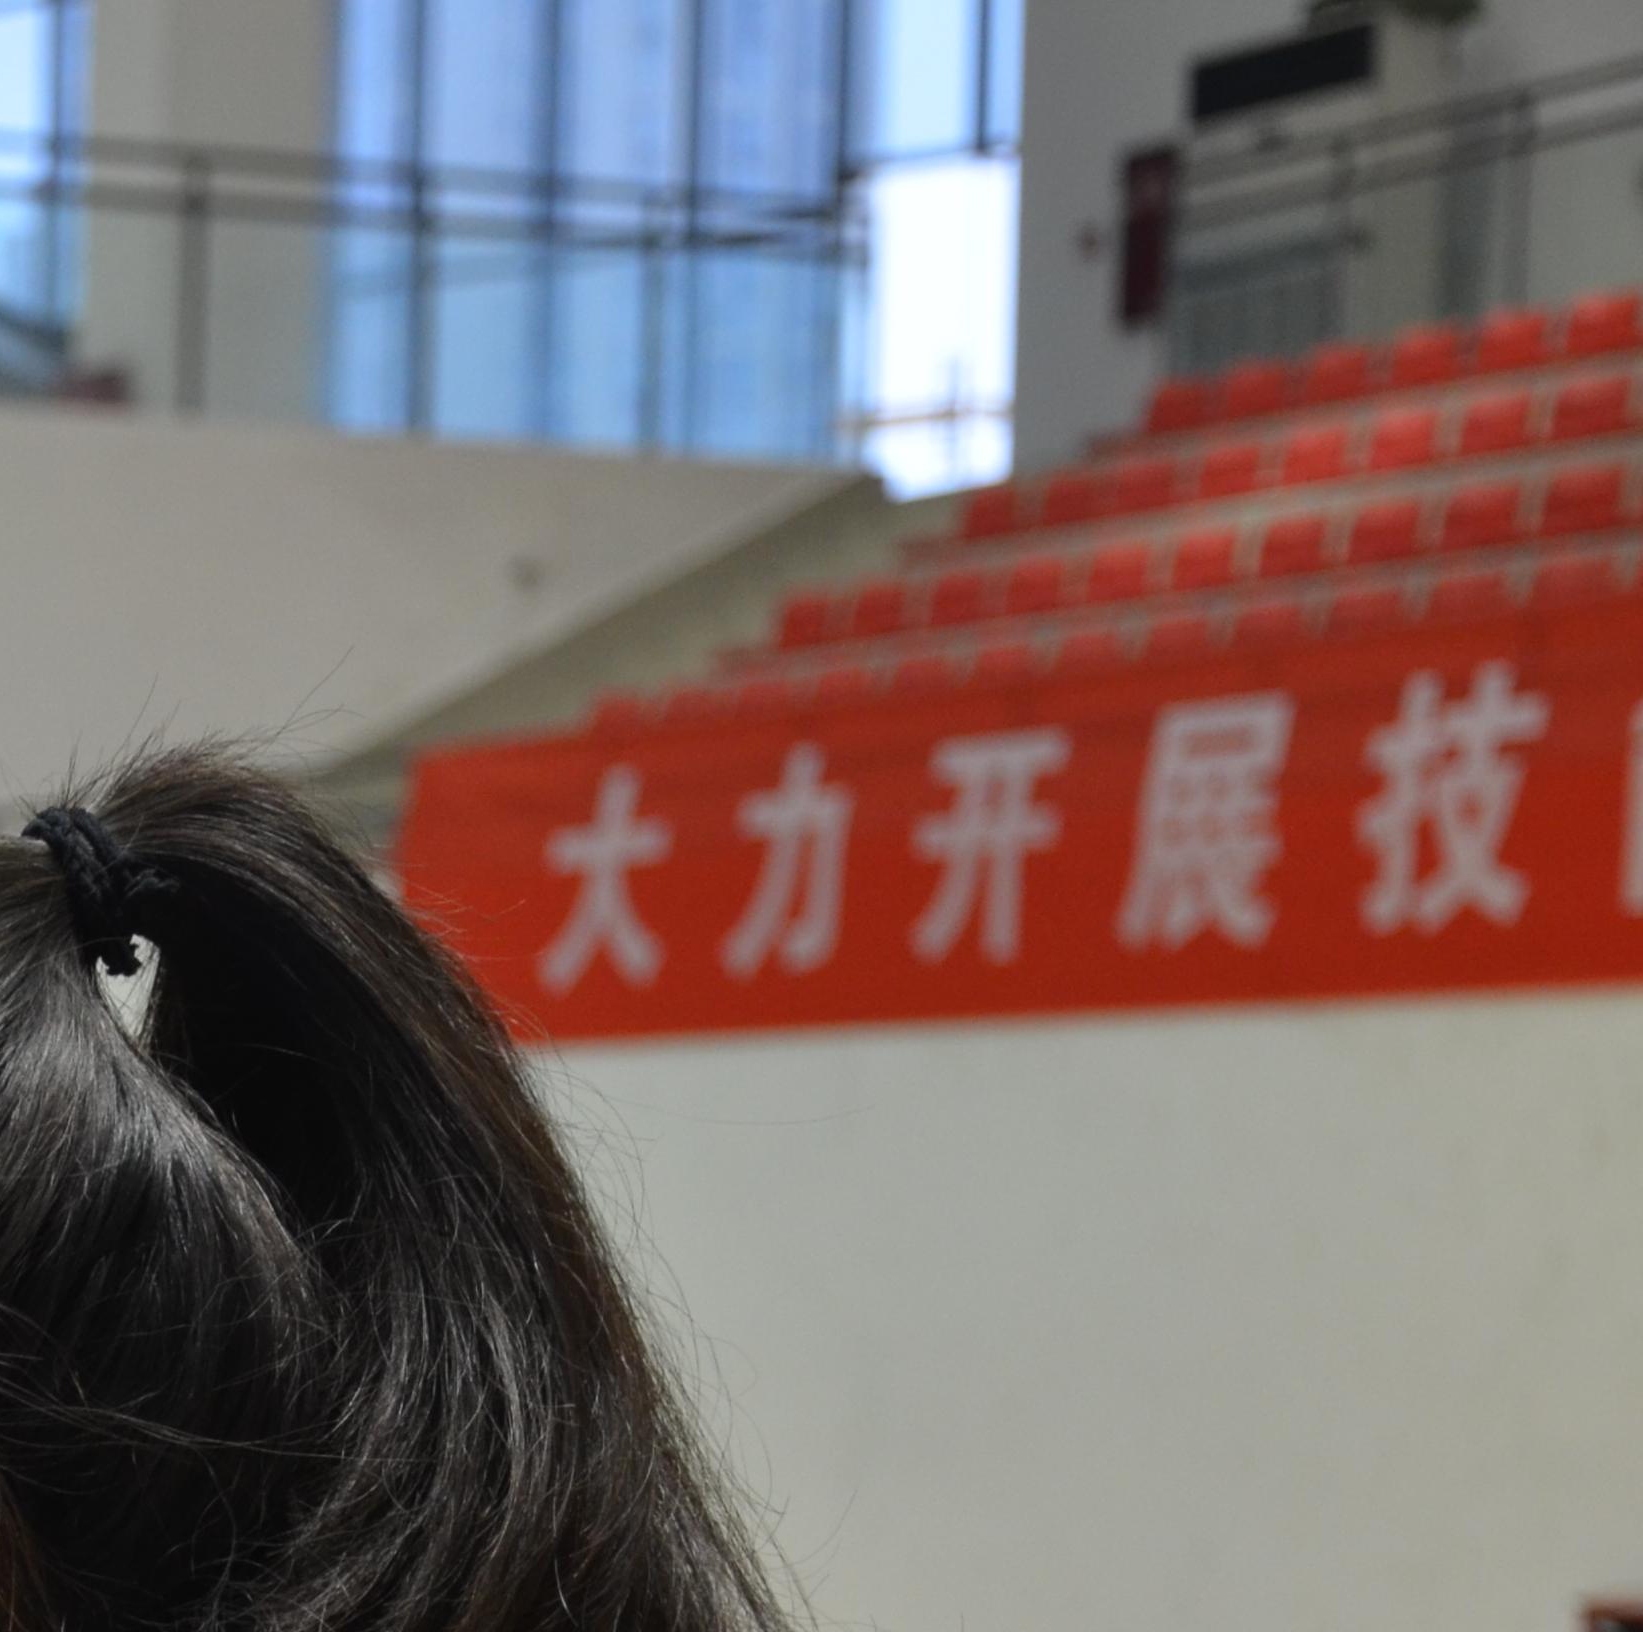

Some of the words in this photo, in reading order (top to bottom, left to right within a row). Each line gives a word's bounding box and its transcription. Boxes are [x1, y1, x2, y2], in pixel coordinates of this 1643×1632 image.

[537, 659, 1643, 996] 大力开展技
